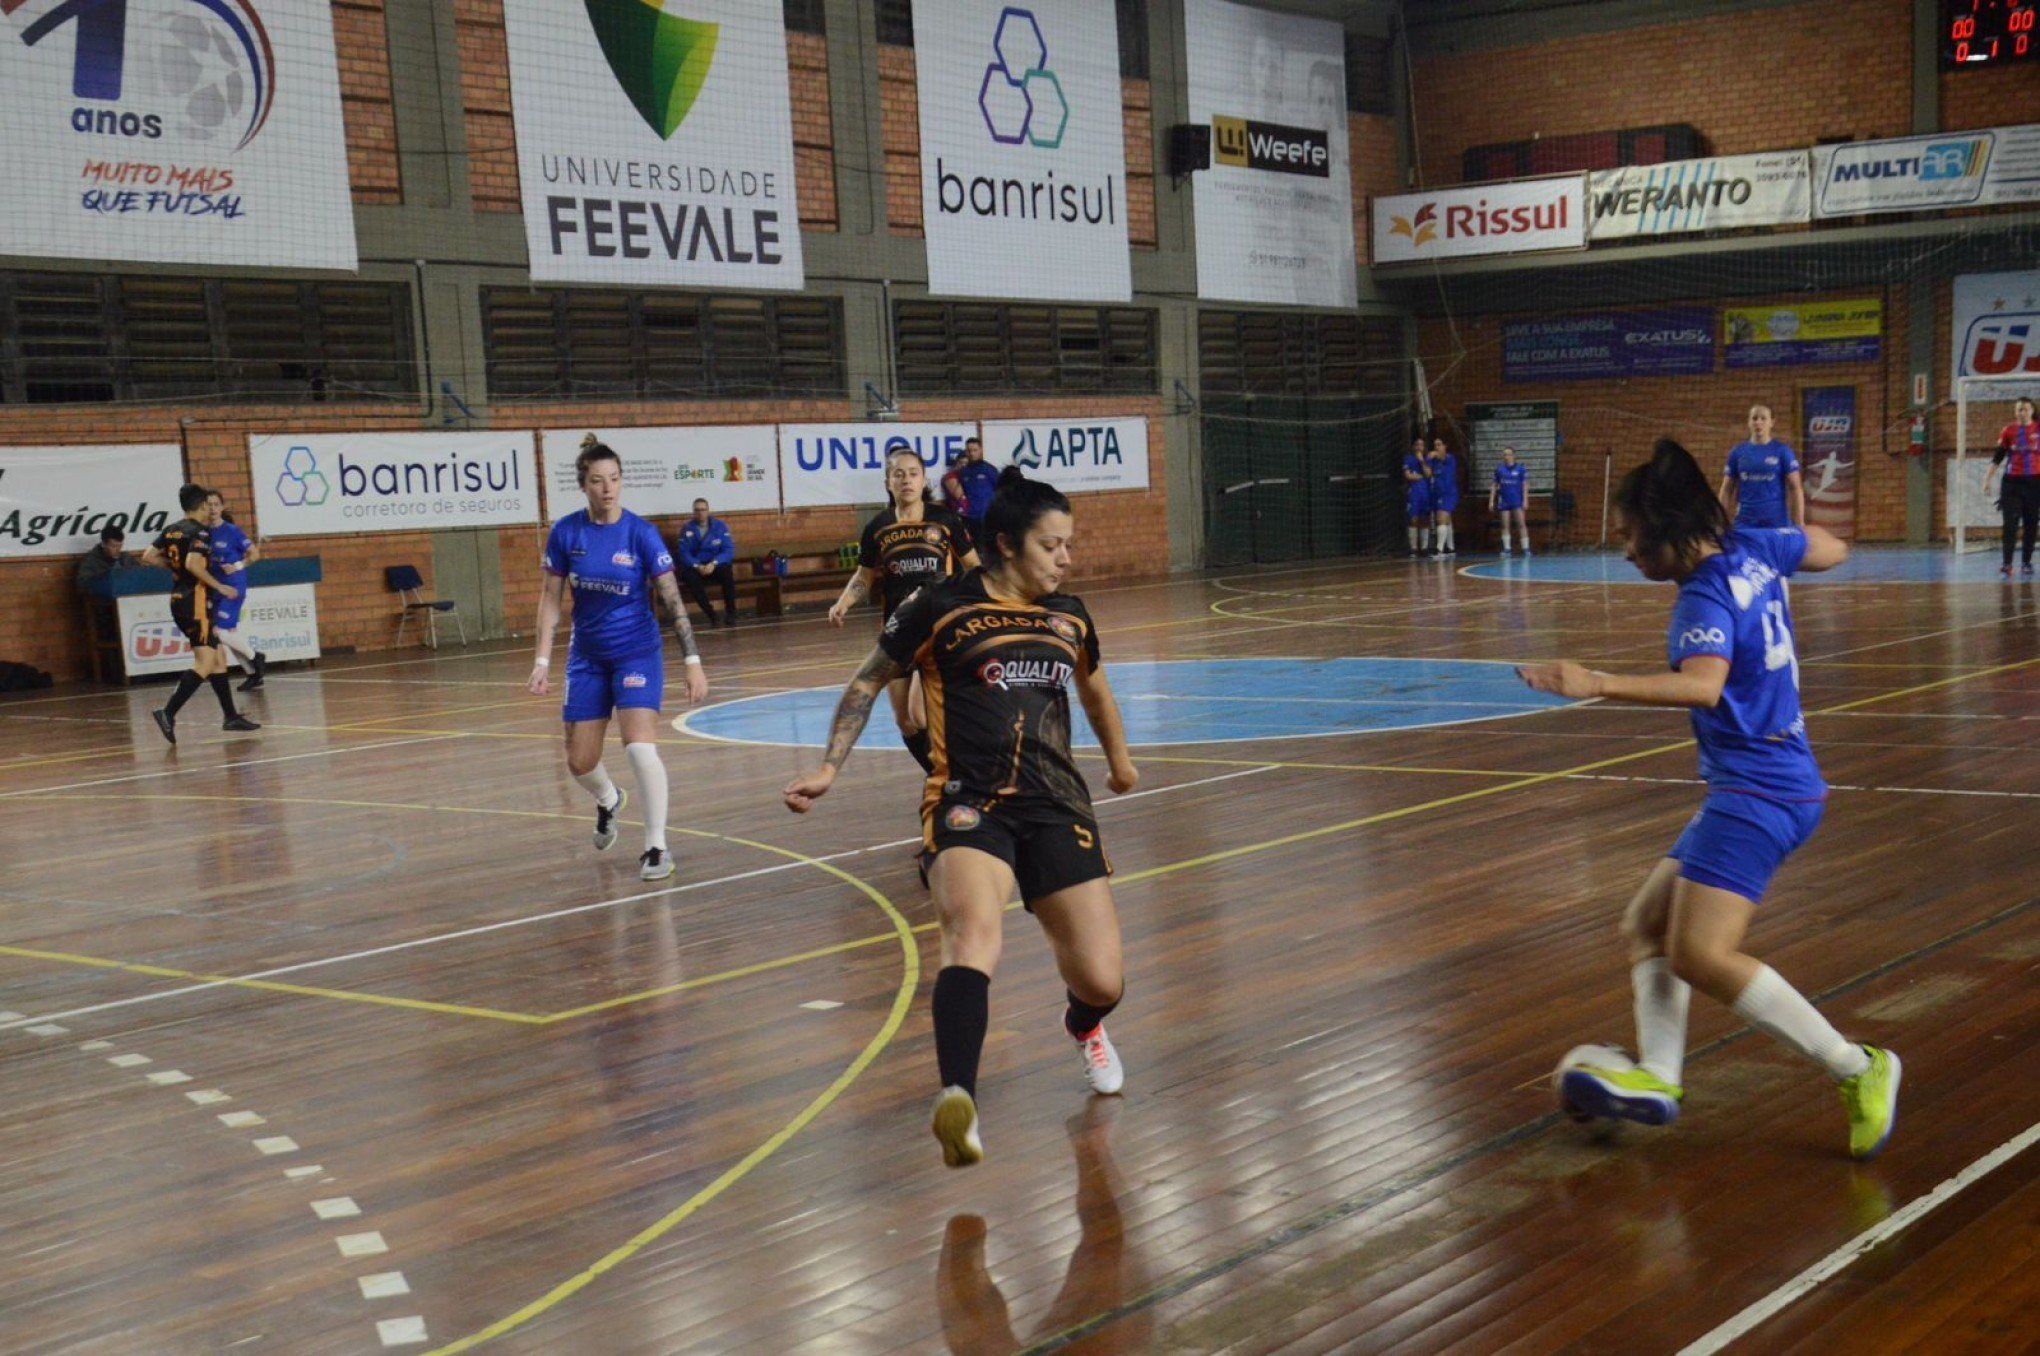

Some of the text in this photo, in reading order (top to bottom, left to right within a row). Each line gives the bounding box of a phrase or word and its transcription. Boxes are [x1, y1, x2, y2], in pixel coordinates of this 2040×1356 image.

[71, 107, 162, 138] anos
[1249, 132, 1327, 167] Weefe
[82, 159, 234, 193] MUITO MAIS
[541, 154, 777, 199] UNIVERSIDADE
[1834, 157, 1920, 182] MULTI
[81, 190, 246, 218] QUE FUTSAL
[936, 157, 1114, 225] banrisul
[1593, 176, 1751, 218] WERANTO
[547, 195, 783, 264] FEEVALE
[1446, 195, 1567, 238] Rissul
[1046, 426, 1123, 468] APTA
[339, 449, 519, 497] banrisul
[0, 502, 169, 546] Agrícola
[342, 498, 521, 518] corretora de seguros
[251, 606, 307, 621] FEEVALE
[249, 632, 311, 650] Banrisul
[1005, 660, 1074, 687] QUALITY
